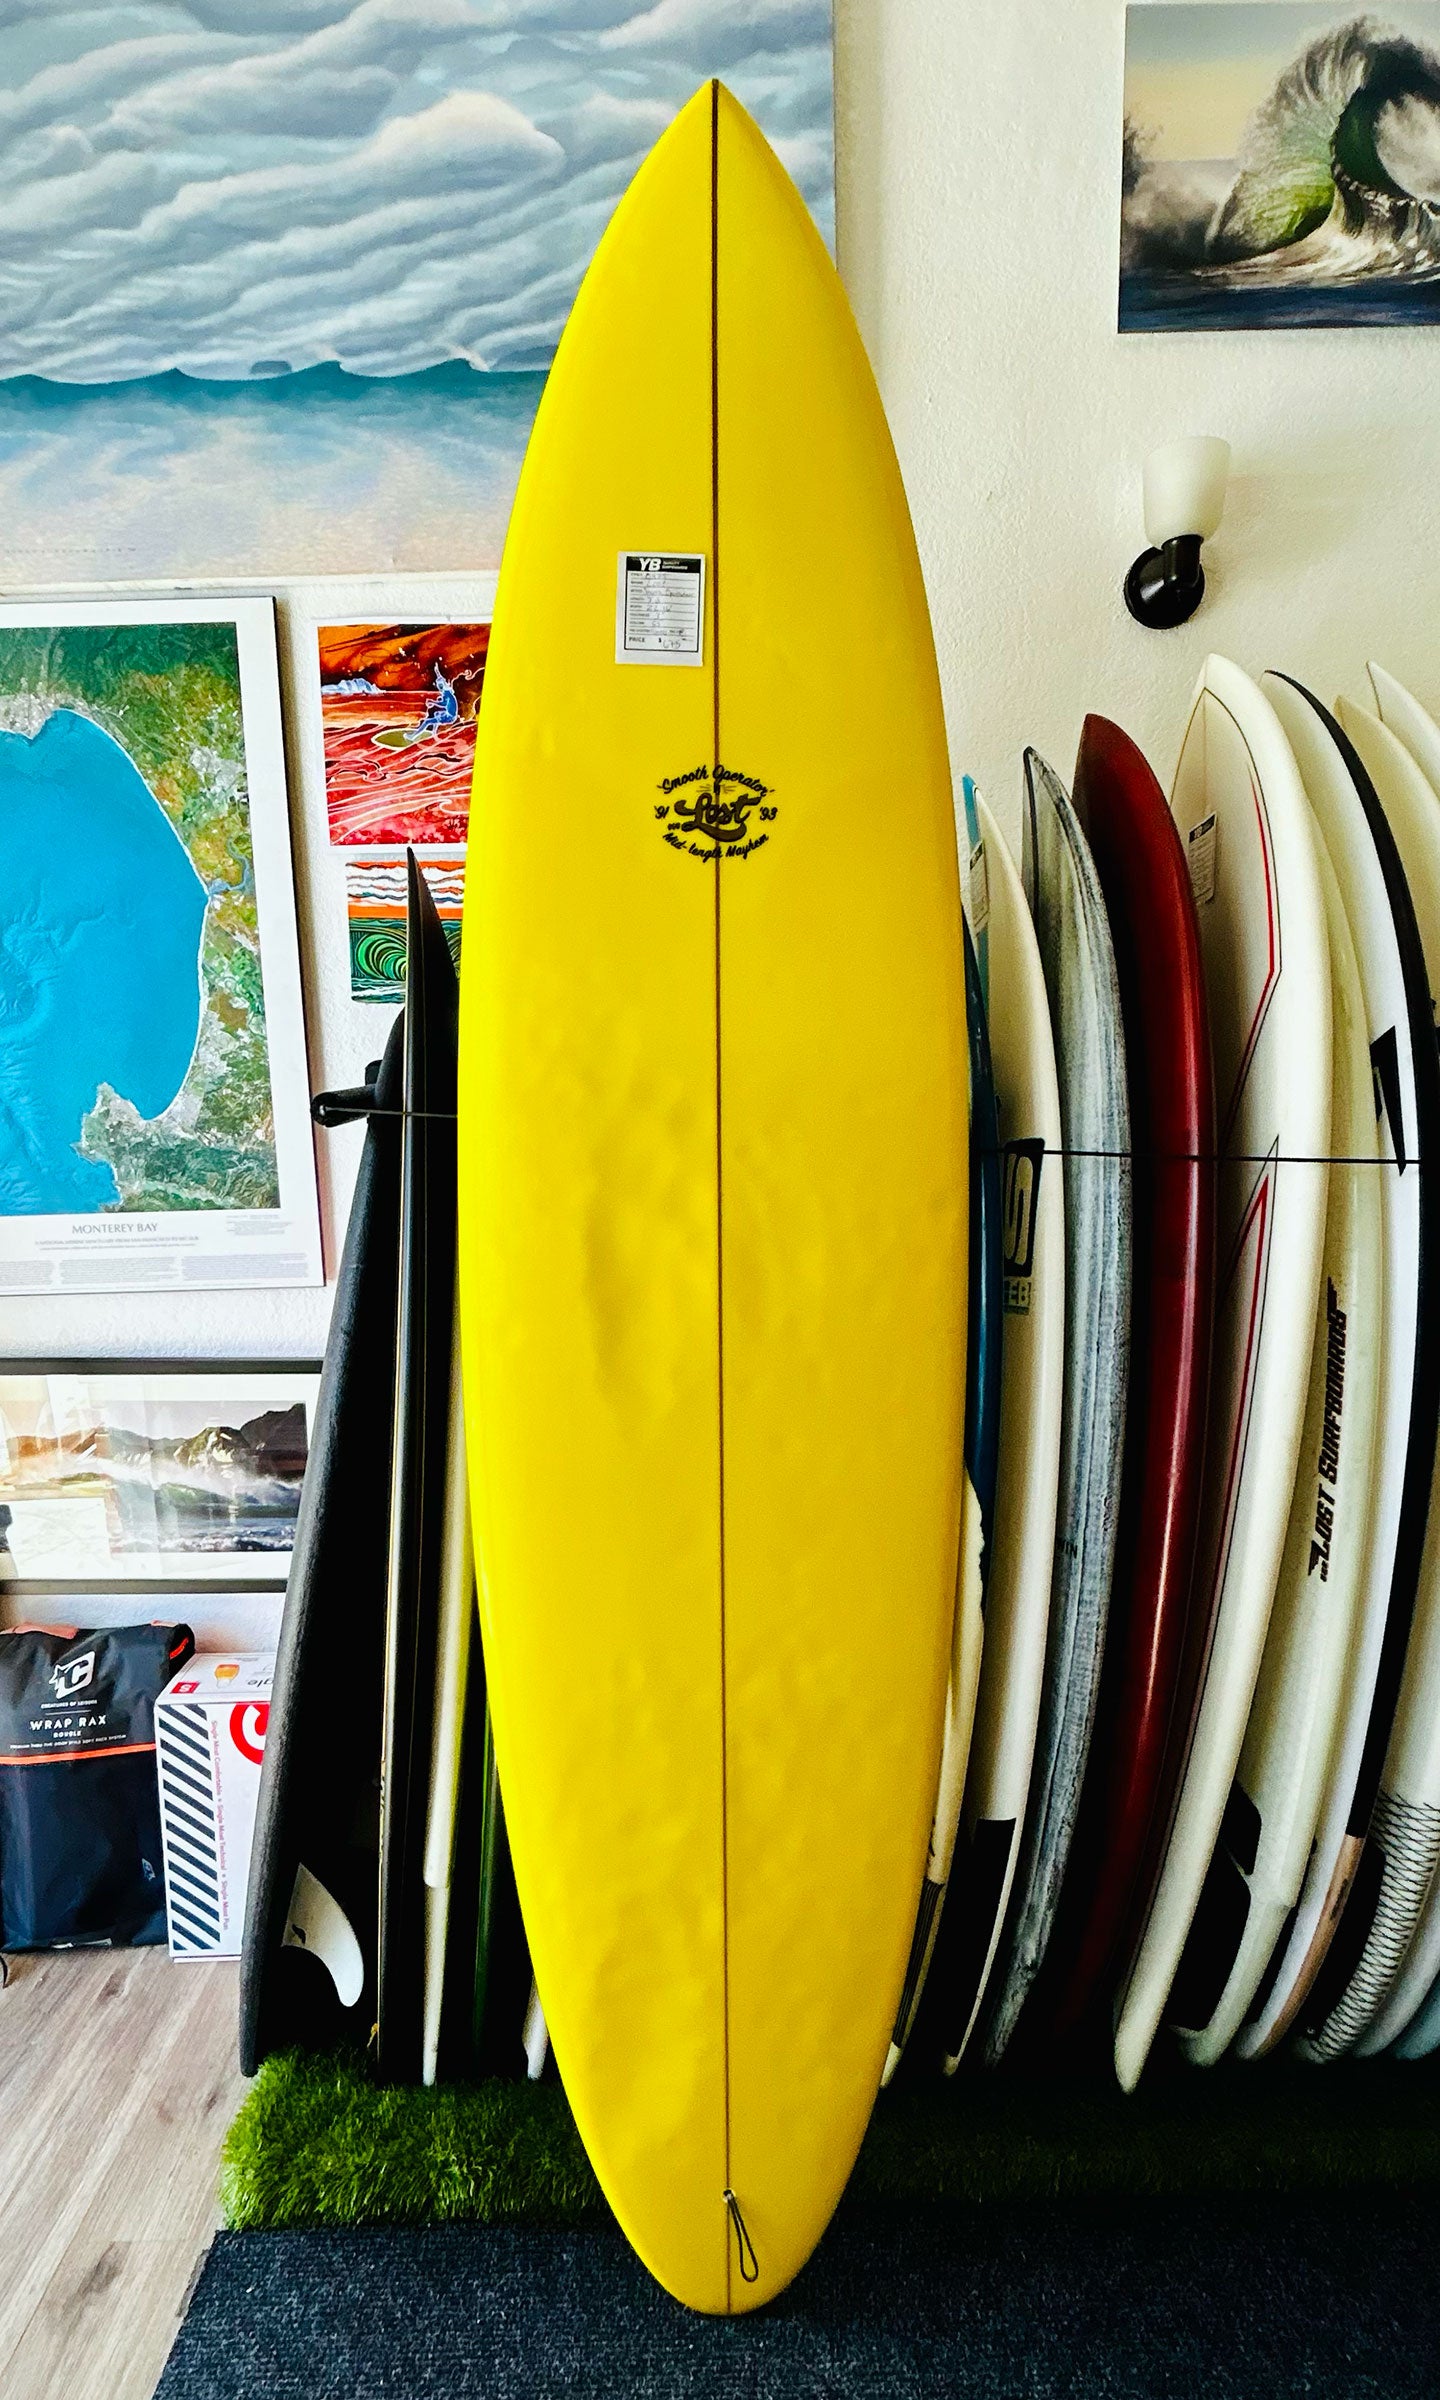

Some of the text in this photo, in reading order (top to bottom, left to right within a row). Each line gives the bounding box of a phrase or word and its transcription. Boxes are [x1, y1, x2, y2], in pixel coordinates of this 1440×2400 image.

[639, 558, 662, 571] YB
[657, 765, 774, 797] Smooth Operator
[725, 834, 769, 860] Mayhem
[72, 1222, 159, 1234] MONTEREY BAY
[30, 1715, 107, 1731] WRAP RAX
